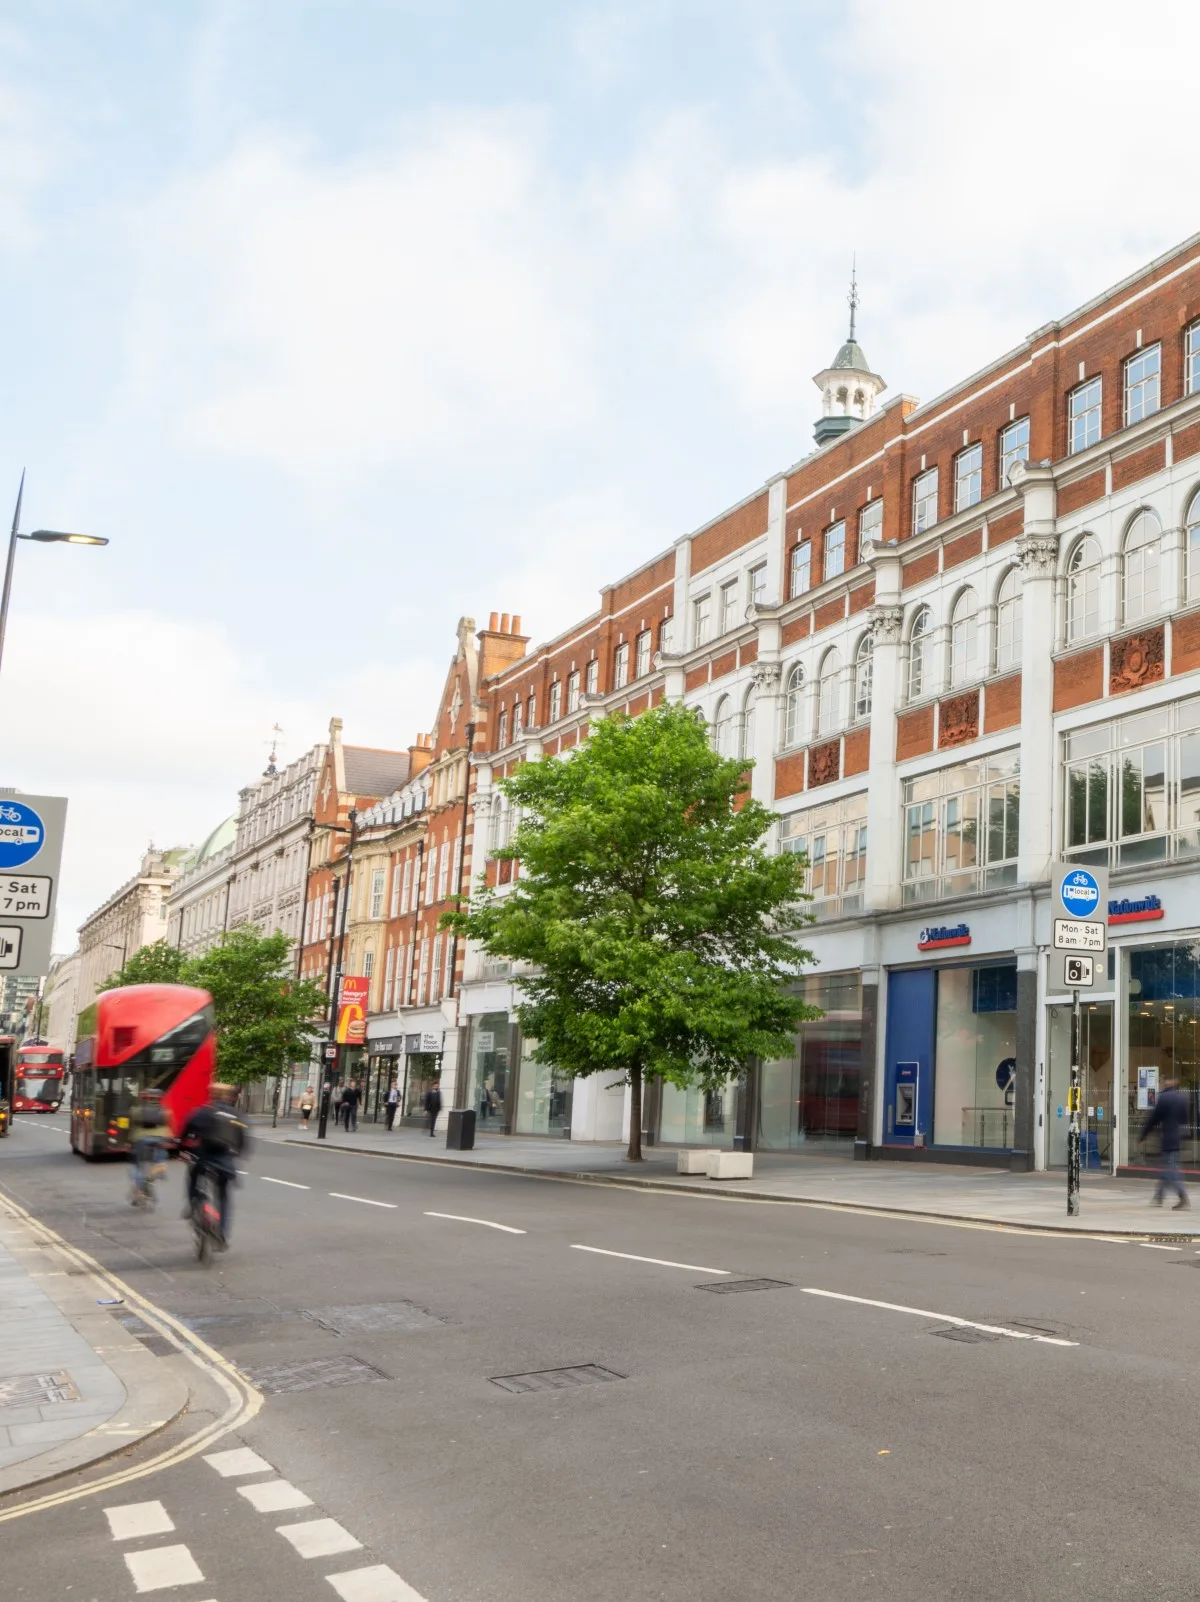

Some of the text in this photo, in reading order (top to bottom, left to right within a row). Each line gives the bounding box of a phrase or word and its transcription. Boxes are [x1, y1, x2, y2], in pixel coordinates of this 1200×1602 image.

[0, 828, 24, 837] ocal
[8, 881, 37, 894] Sat
[3, 897, 40, 911] 7 pm
[1108, 895, 1161, 915] Nationwide
[930, 924, 969, 941] Nationwide
[1061, 924, 1078, 933] Mon
[1085, 926, 1099, 935] Sat
[1058, 935, 1064, 944] 8
[1082, 937, 1088, 945] 7
